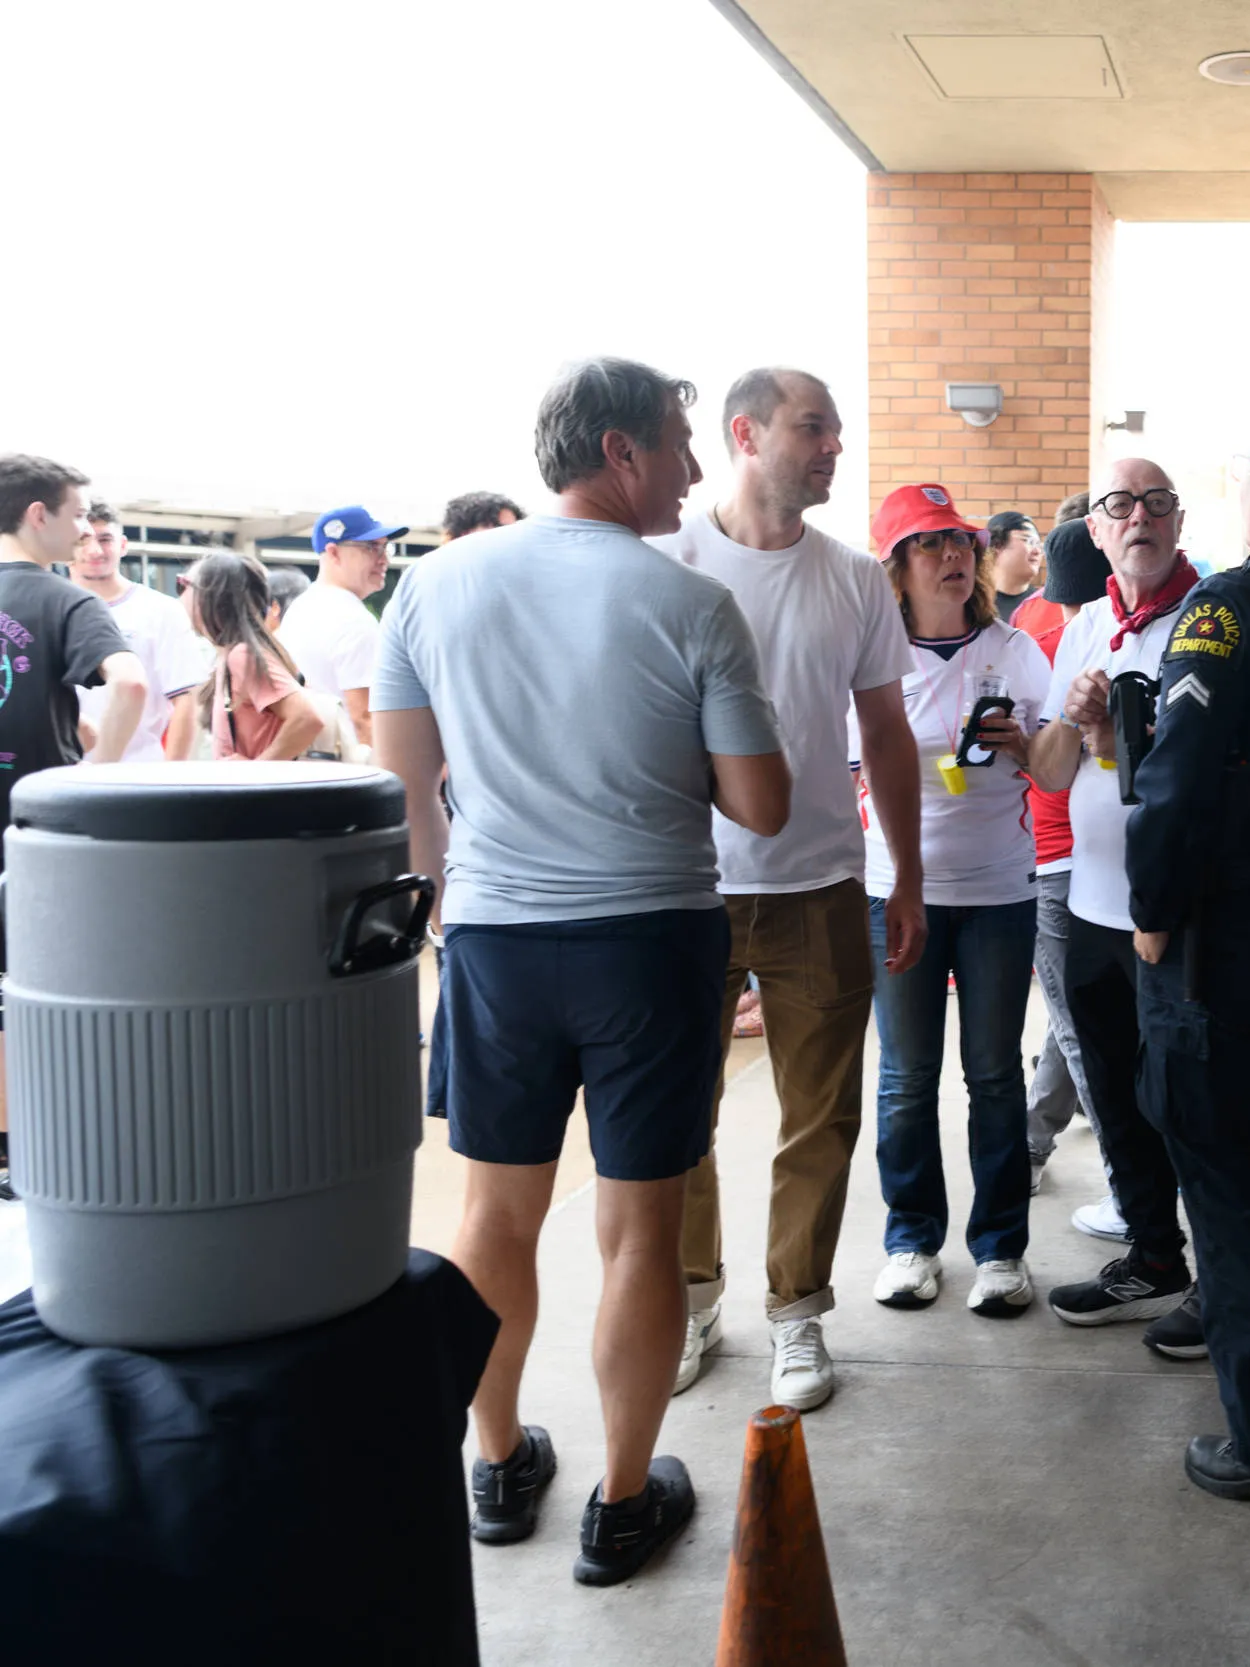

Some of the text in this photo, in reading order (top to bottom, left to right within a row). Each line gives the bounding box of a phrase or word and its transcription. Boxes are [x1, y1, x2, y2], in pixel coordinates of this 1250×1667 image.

[1174, 604, 1241, 646] DALLAS POLICE
[1171, 638, 1234, 659] DEPARTMENT
